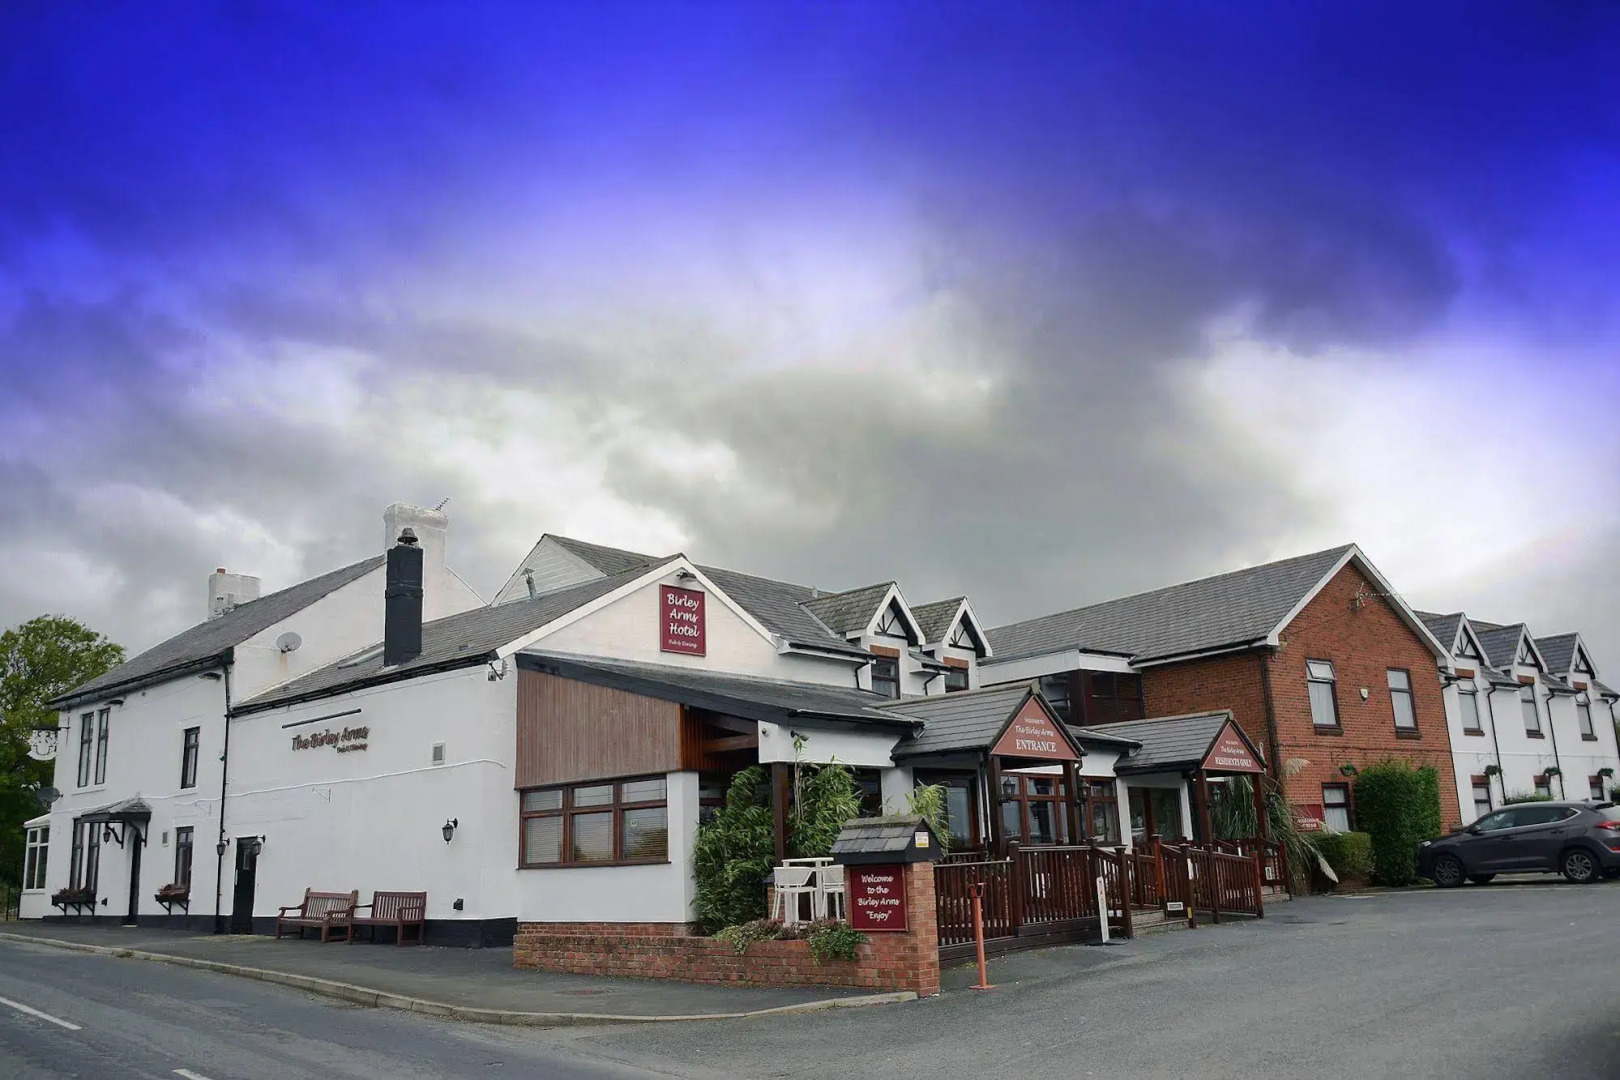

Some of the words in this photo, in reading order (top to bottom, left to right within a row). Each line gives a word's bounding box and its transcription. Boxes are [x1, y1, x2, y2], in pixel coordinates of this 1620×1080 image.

[667, 593, 699, 611] Birley
[669, 608, 699, 623] Arms
[669, 622, 700, 637] Hotel
[1015, 725, 1025, 734] The
[1025, 726, 1041, 737] Birley
[1041, 728, 1055, 737] Arms
[292, 734, 310, 751] The
[310, 728, 340, 749] Birley
[341, 726, 369, 742] Arms
[1015, 739, 1057, 753] ENTRANCE
[1215, 756, 1240, 766] RESIDENTS
[861, 874, 894, 883] Welcome
[867, 886, 875, 894] to
[875, 885, 889, 894] the
[858, 896, 880, 908] Birley
[880, 897, 900, 906] Arms
